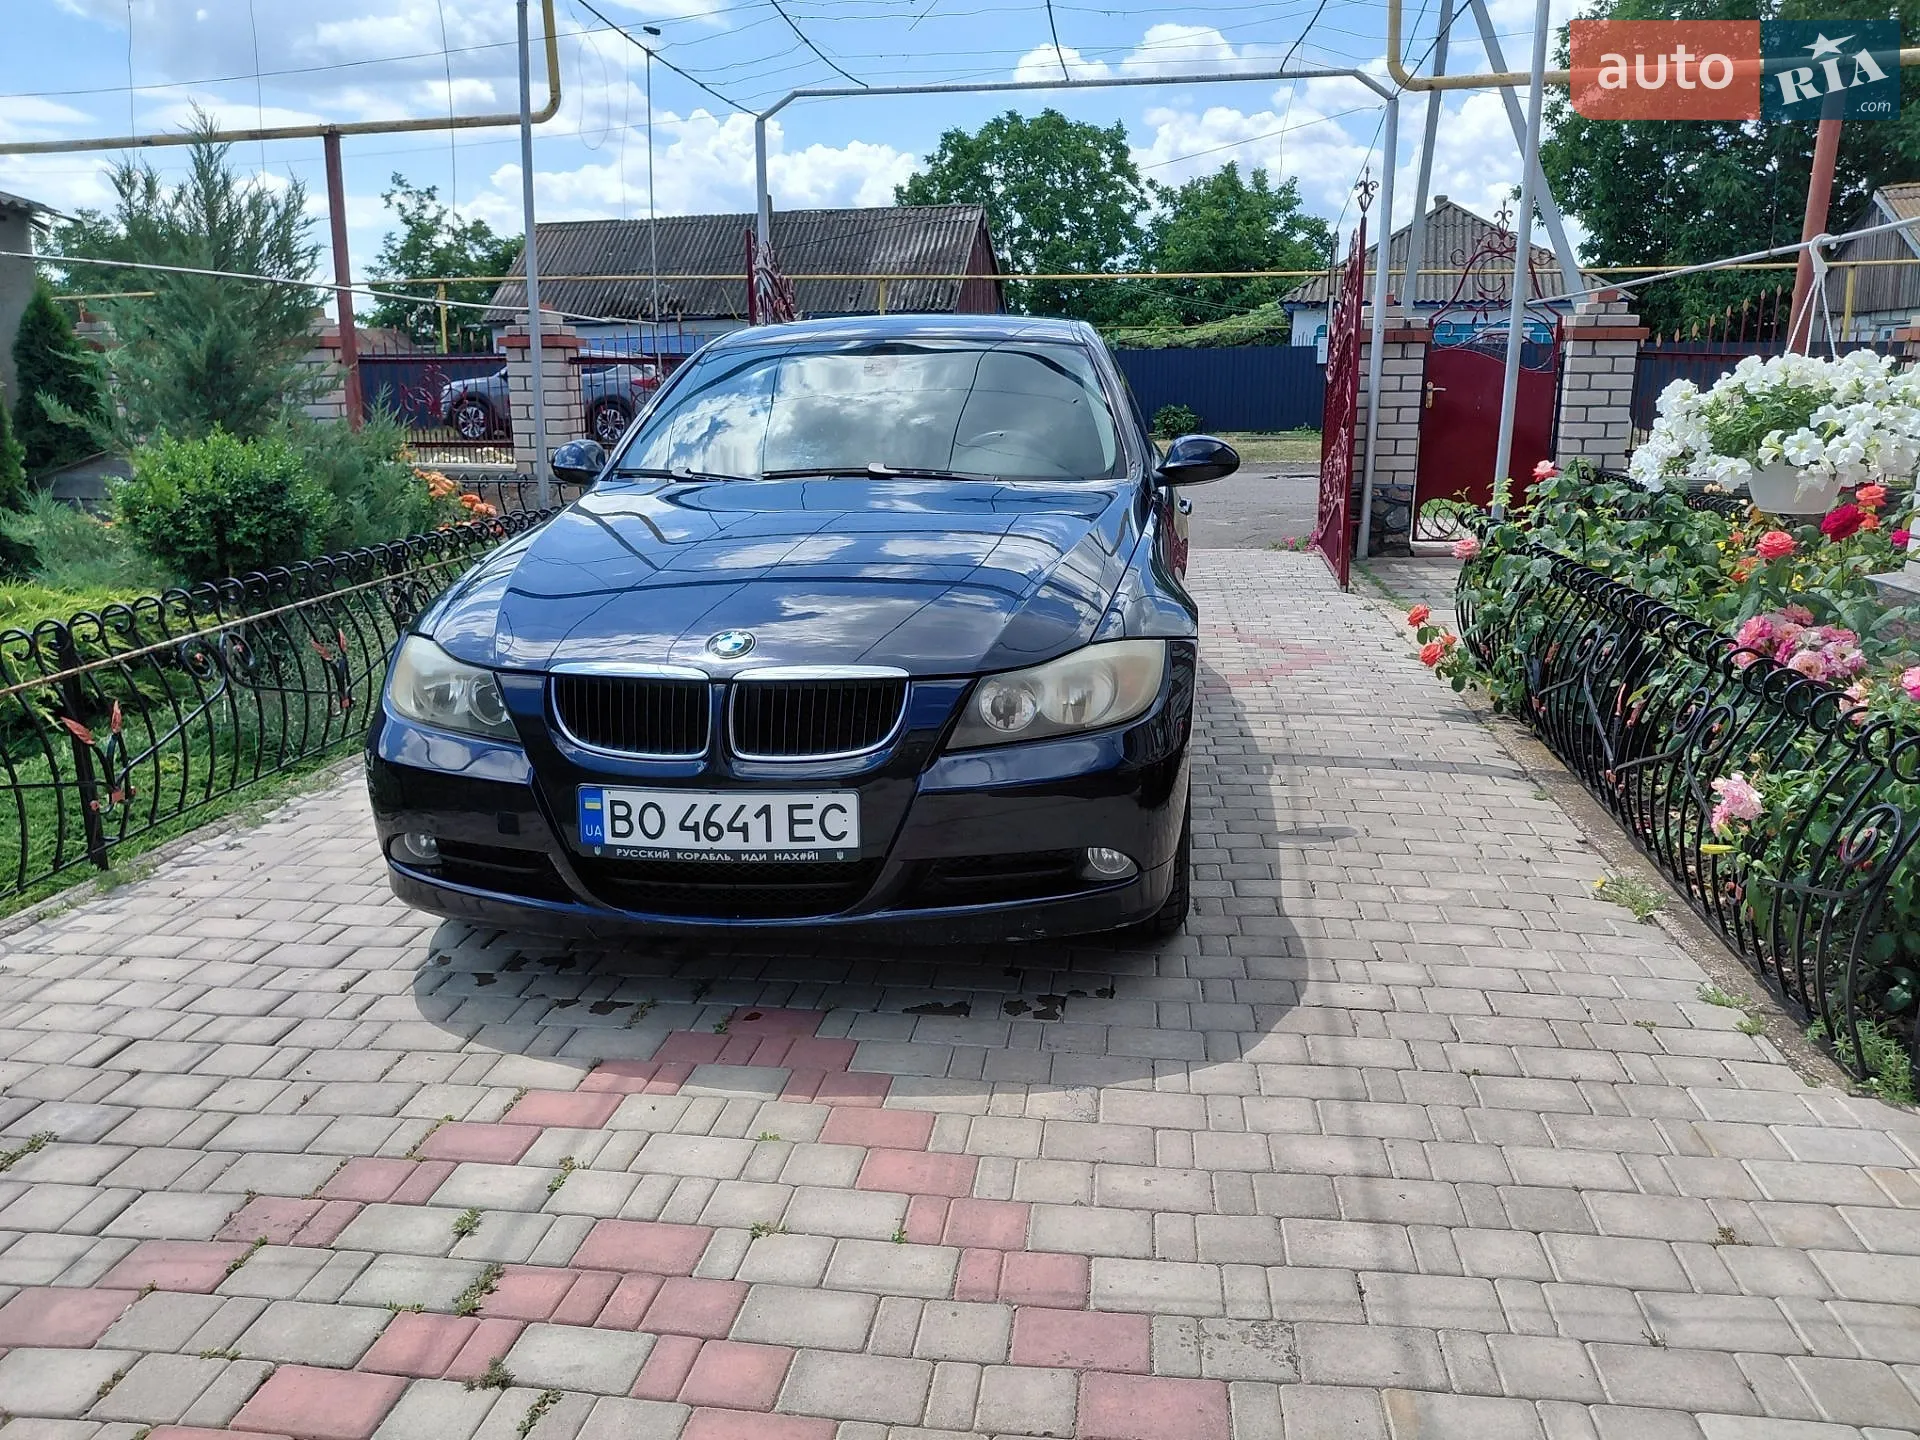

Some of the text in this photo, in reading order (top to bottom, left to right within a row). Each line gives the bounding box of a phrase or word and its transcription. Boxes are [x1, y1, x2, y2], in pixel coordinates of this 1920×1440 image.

[609, 799, 848, 843] BO 4641 EC
[585, 824, 602, 837] UA
[616, 848, 670, 859] РУССКИЙ
[741, 853, 767, 862] ИДИ
